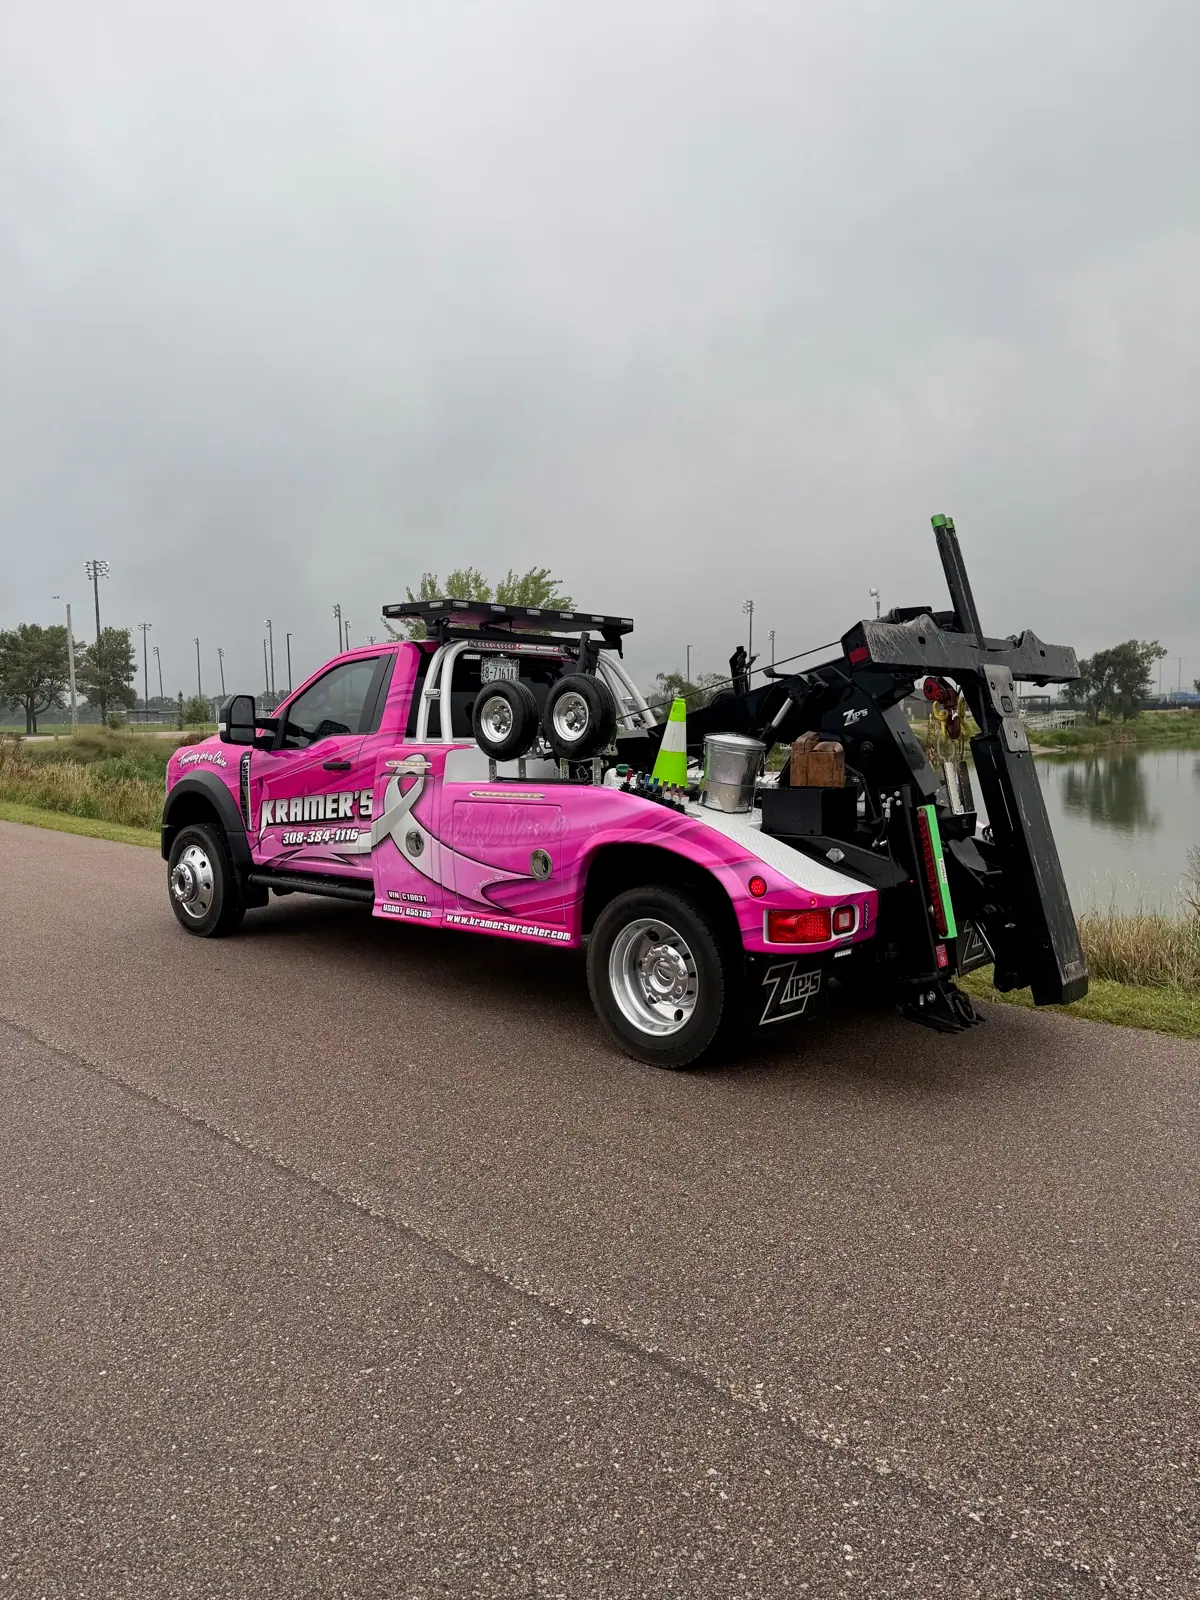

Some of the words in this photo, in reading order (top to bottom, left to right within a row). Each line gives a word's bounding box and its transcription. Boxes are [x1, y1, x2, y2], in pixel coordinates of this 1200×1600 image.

[178, 750, 199, 768] Towing
[213, 750, 227, 768] Cure
[261, 789, 374, 829] KRAMER'S
[282, 828, 360, 845] 308-384-1116
[387, 891, 400, 899] VIN
[382, 904, 404, 914] USDOT
[446, 914, 571, 941] www.kramerswrecker.com
